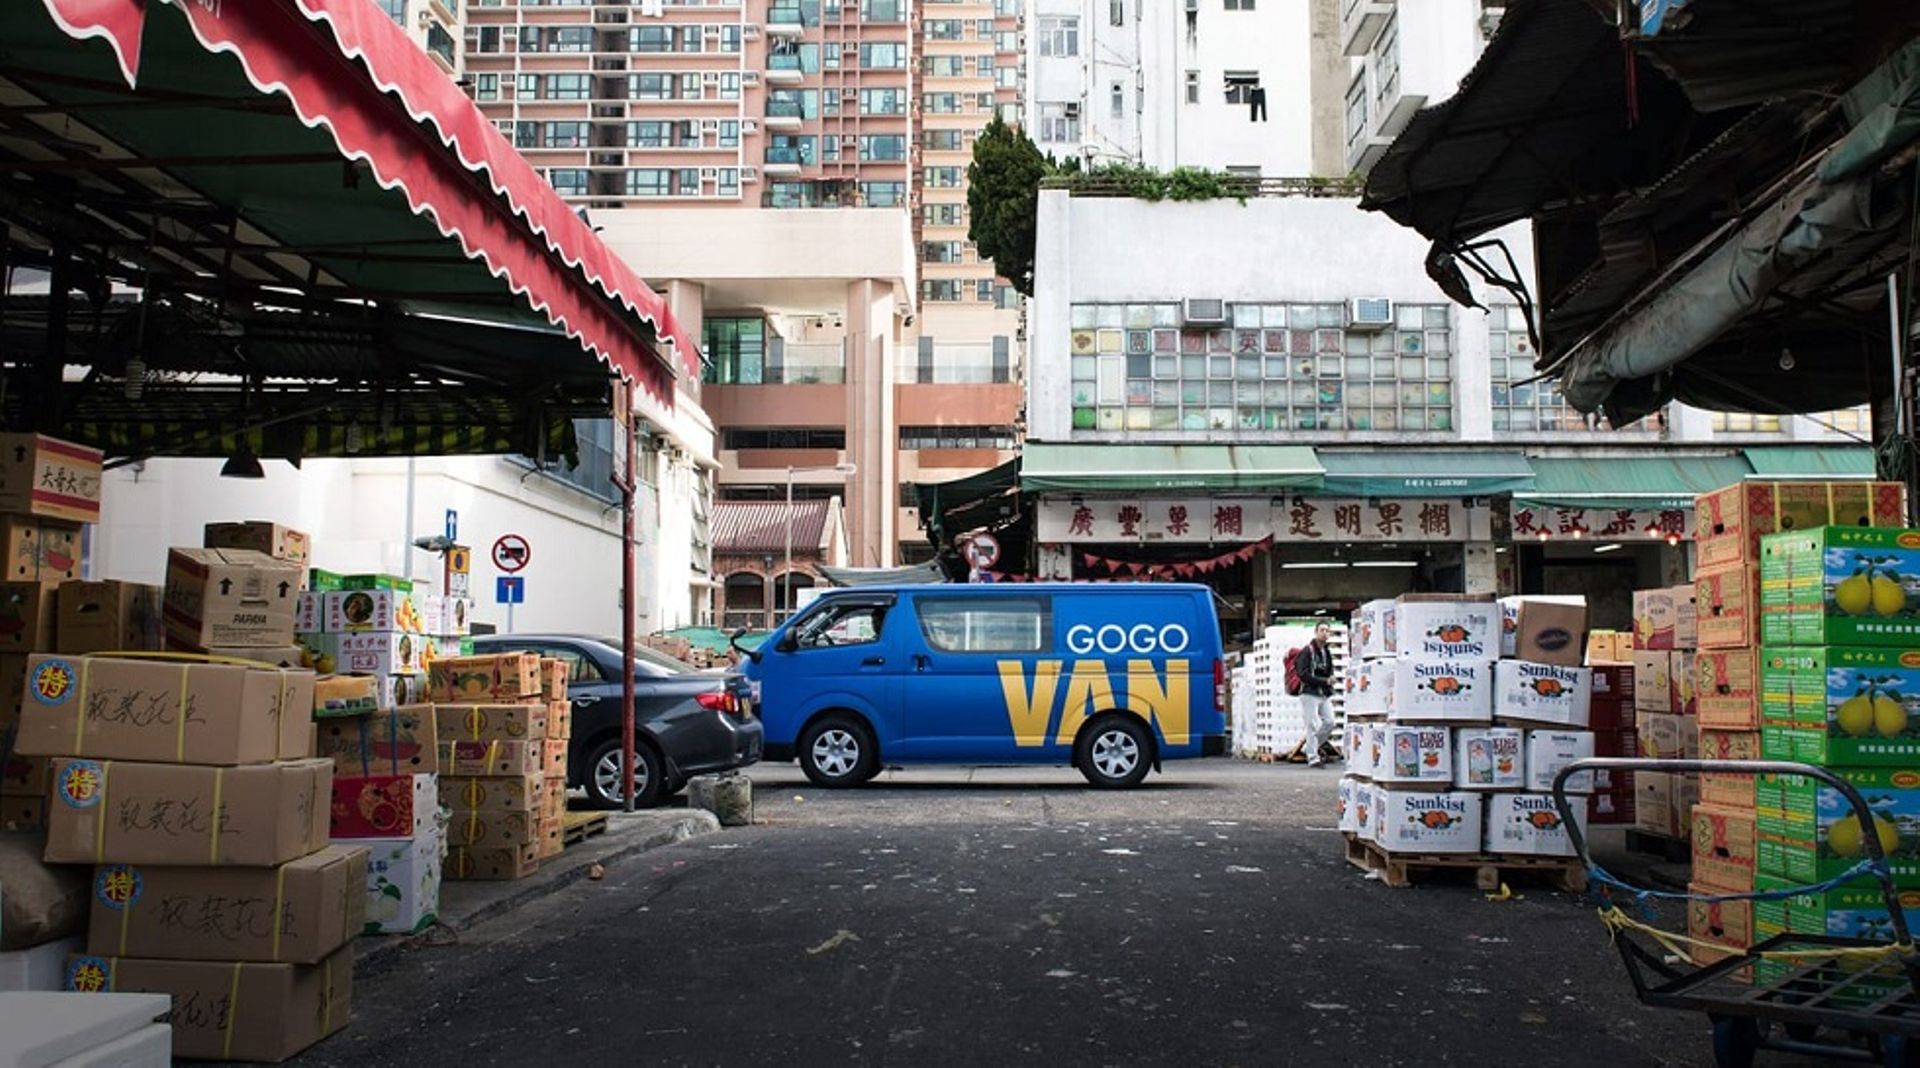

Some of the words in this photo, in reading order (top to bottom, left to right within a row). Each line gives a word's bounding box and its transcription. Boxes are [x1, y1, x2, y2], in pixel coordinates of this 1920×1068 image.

[233, 613, 267, 626] PAPAYA
[1067, 624, 1189, 654] GOGO
[1423, 641, 1483, 656] Sunkist
[39, 666, 68, 697] 特
[1414, 663, 1475, 679] Sunkist
[1518, 663, 1579, 684] Sunkist
[996, 659, 1189, 746] VAN
[67, 768, 97, 798] 特
[1405, 796, 1466, 813] Sunkist
[104, 870, 134, 899] 特
[75, 966, 104, 992] 特
